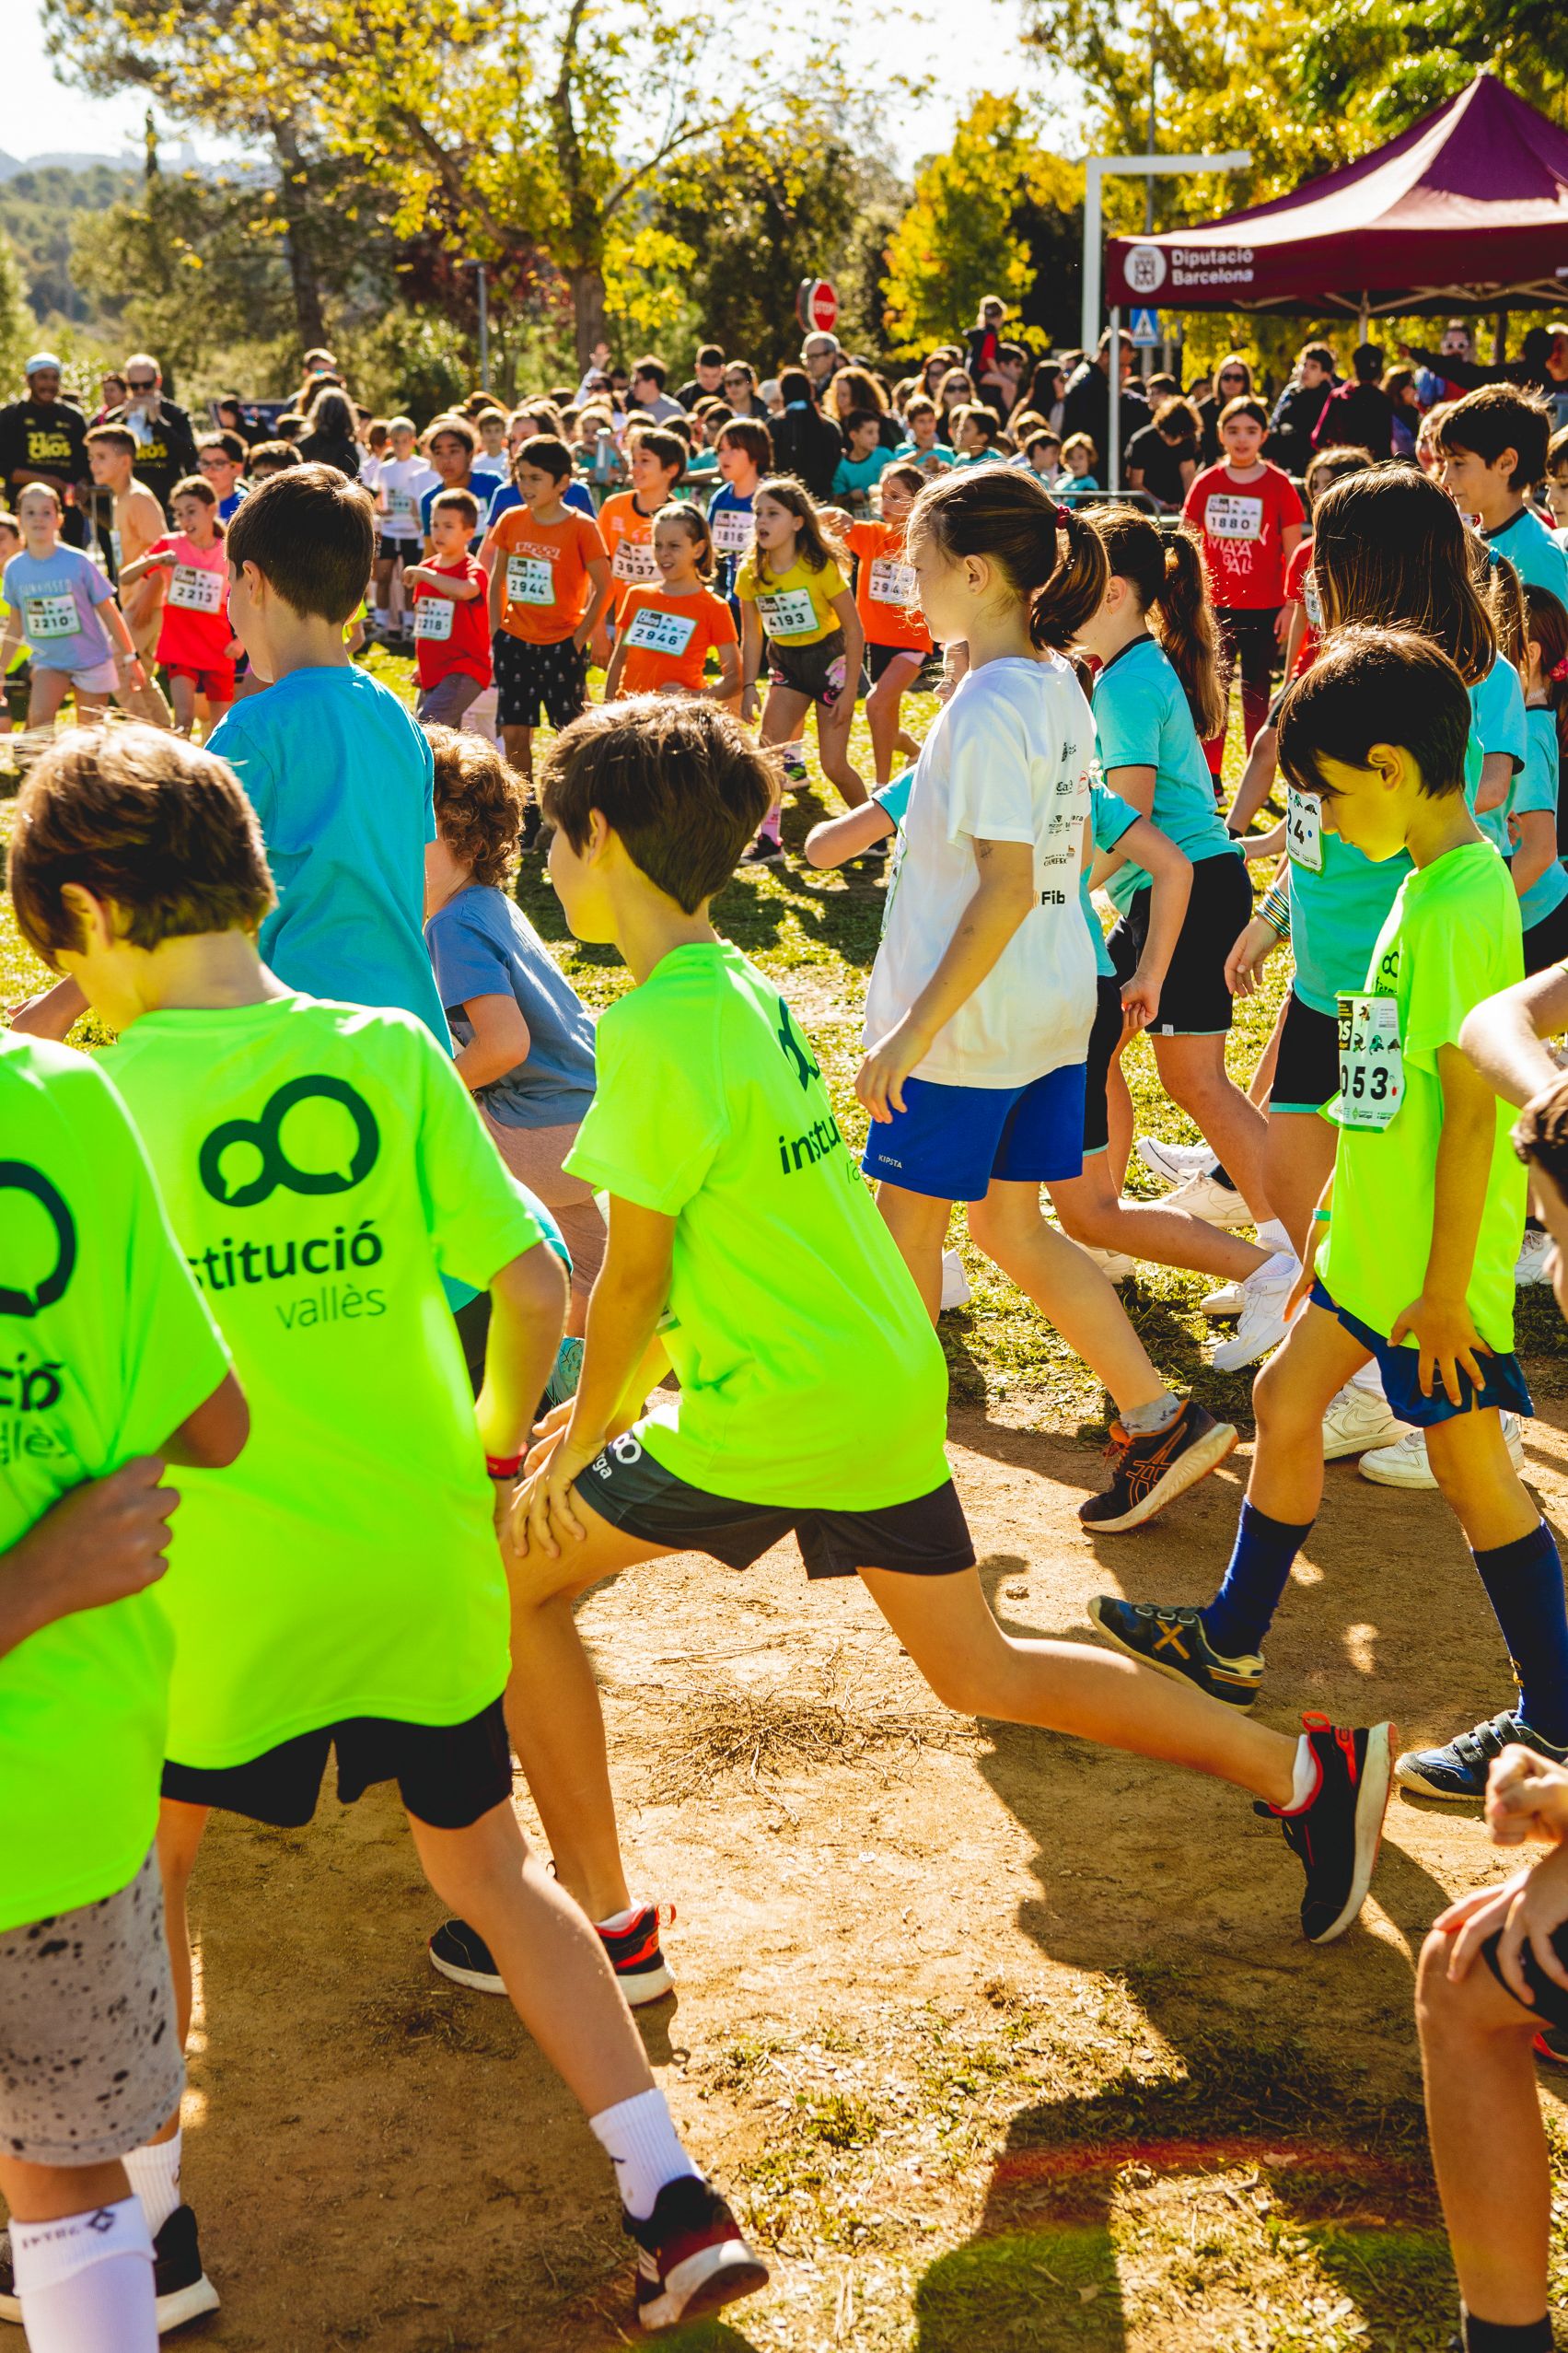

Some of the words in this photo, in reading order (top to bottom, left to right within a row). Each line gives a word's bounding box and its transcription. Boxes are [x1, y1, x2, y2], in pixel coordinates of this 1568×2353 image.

[1171, 247, 1254, 268] Diputació
[1171, 267, 1254, 285] Barcelona
[1211, 517, 1250, 530] 1880
[177, 587, 213, 603] 2213
[511, 579, 545, 595] 2944
[769, 612, 806, 627] 4193
[634, 628, 679, 646] 2946
[1041, 891, 1065, 905] Fib
[878, 1154, 902, 1169] KIPSTA
[276, 1283, 387, 1330] vallès
